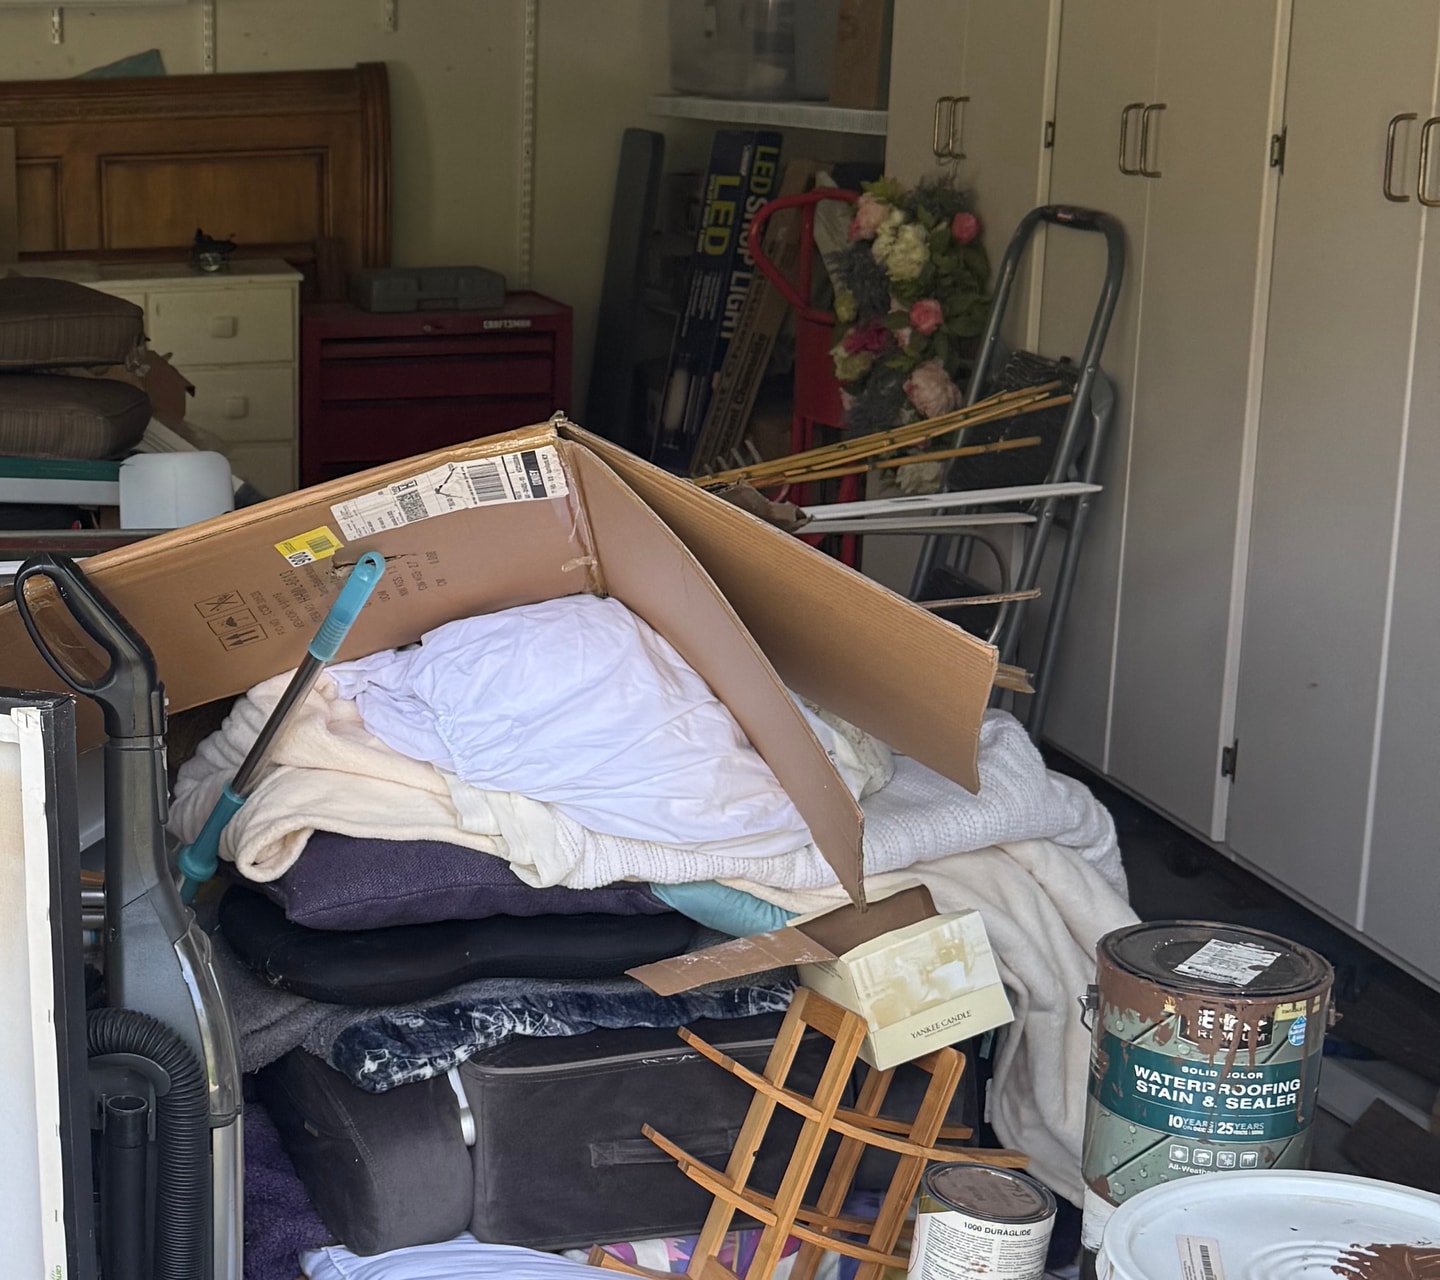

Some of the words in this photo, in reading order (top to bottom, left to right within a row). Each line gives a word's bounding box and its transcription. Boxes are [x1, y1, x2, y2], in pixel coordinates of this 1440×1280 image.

[750, 145, 779, 195] LED
[703, 175, 741, 255] LED
[720, 271, 754, 339] LIGHT
[910, 1023, 940, 1039] YANKEE
[941, 1010, 972, 1027] CANDLE
[1134, 1064, 1301, 1097] WATERPROOFING
[1181, 1065, 1218, 1077] SOLID
[1135, 1079, 1194, 1105] STAIN
[1202, 1096, 1216, 1108] &
[1225, 1093, 1297, 1110] SEALER
[1168, 1114, 1183, 1129] 10
[1216, 1122, 1234, 1135] 25
[1234, 1122, 1265, 1131] YEARS
